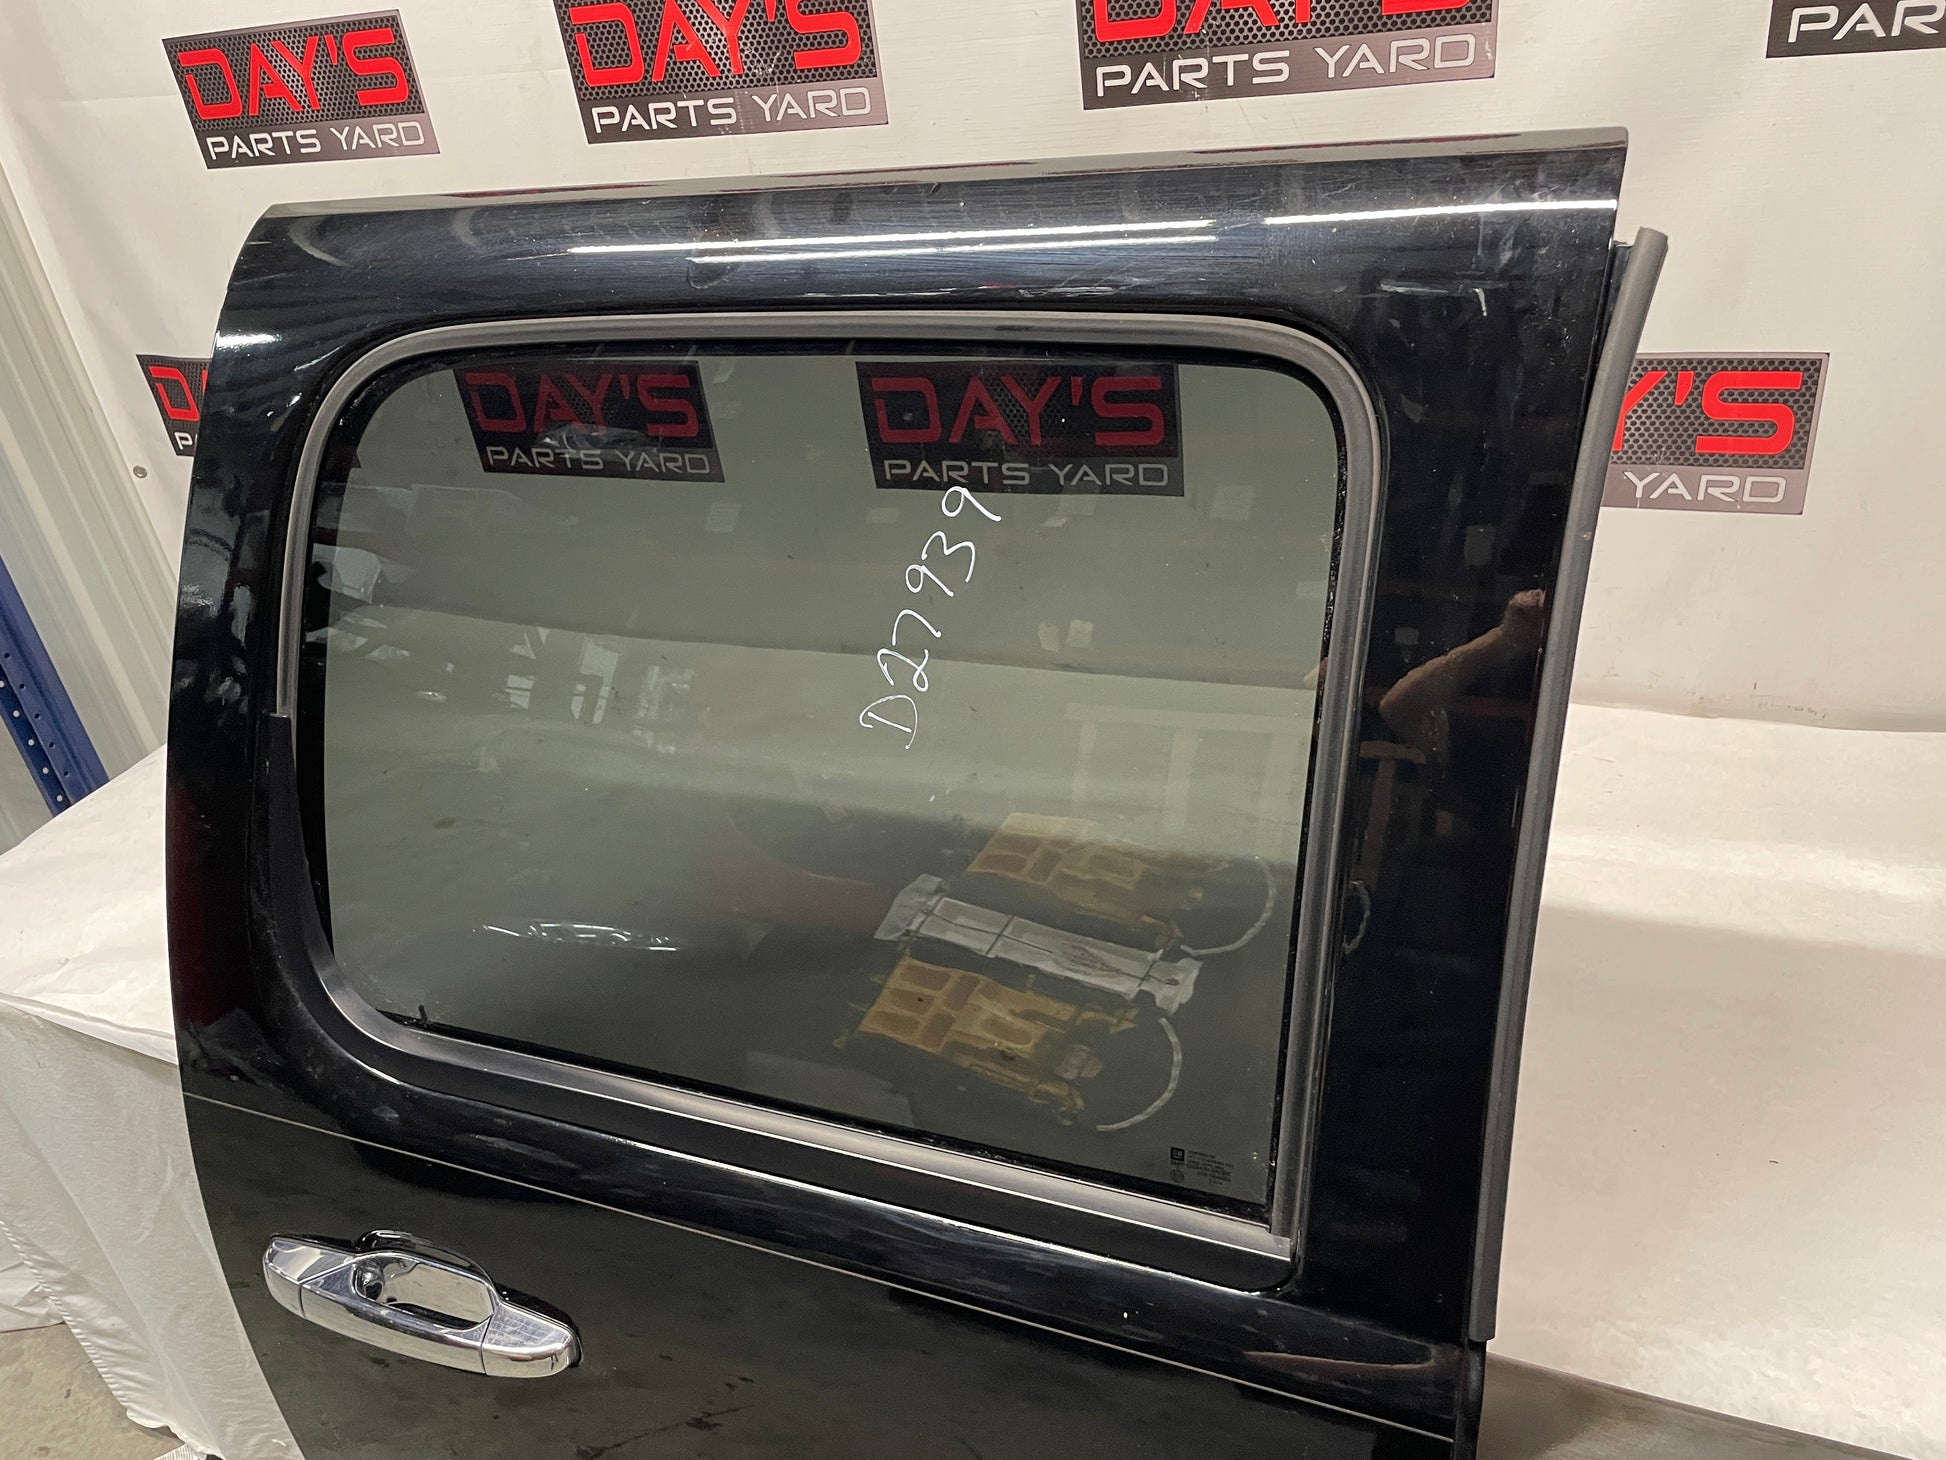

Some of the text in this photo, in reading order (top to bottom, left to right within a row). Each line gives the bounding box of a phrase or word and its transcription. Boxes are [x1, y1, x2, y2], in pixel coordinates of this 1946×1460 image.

[177, 28, 409, 120] DAY'S
[568, 0, 862, 87] DAY'S
[1096, 33, 1476, 97] PARTS YARD
[205, 121, 425, 160] PARTS YARD
[591, 87, 872, 134] PARTS YARD
[464, 371, 699, 437] DAY'S
[871, 375, 1165, 446] DAY'S
[486, 446, 710, 474] PARTS YARD
[883, 459, 1169, 487] PARTS YARD
[1623, 471, 1787, 503] YARD
[859, 486, 1001, 750] D27939
